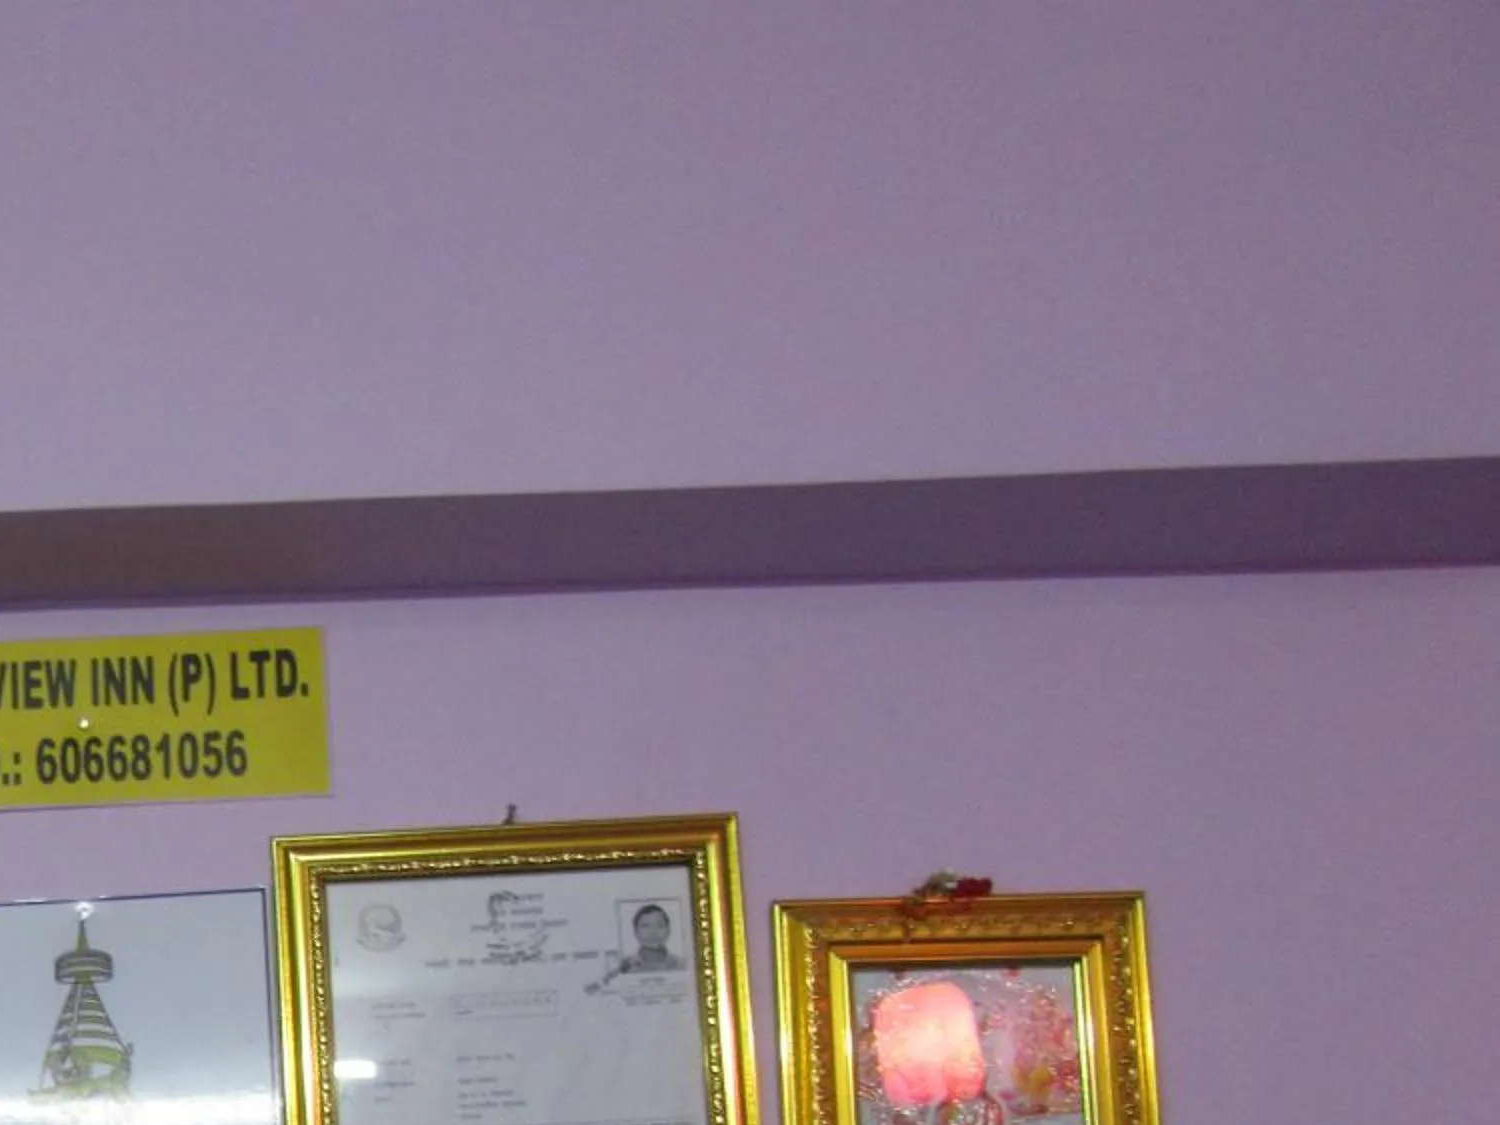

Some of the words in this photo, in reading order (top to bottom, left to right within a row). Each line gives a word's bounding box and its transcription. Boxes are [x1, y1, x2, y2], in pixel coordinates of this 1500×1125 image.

[91, 655, 155, 706] INN
[168, 652, 217, 717] (P)
[229, 649, 309, 700] LTD.
[36, 730, 248, 784] 606681056
